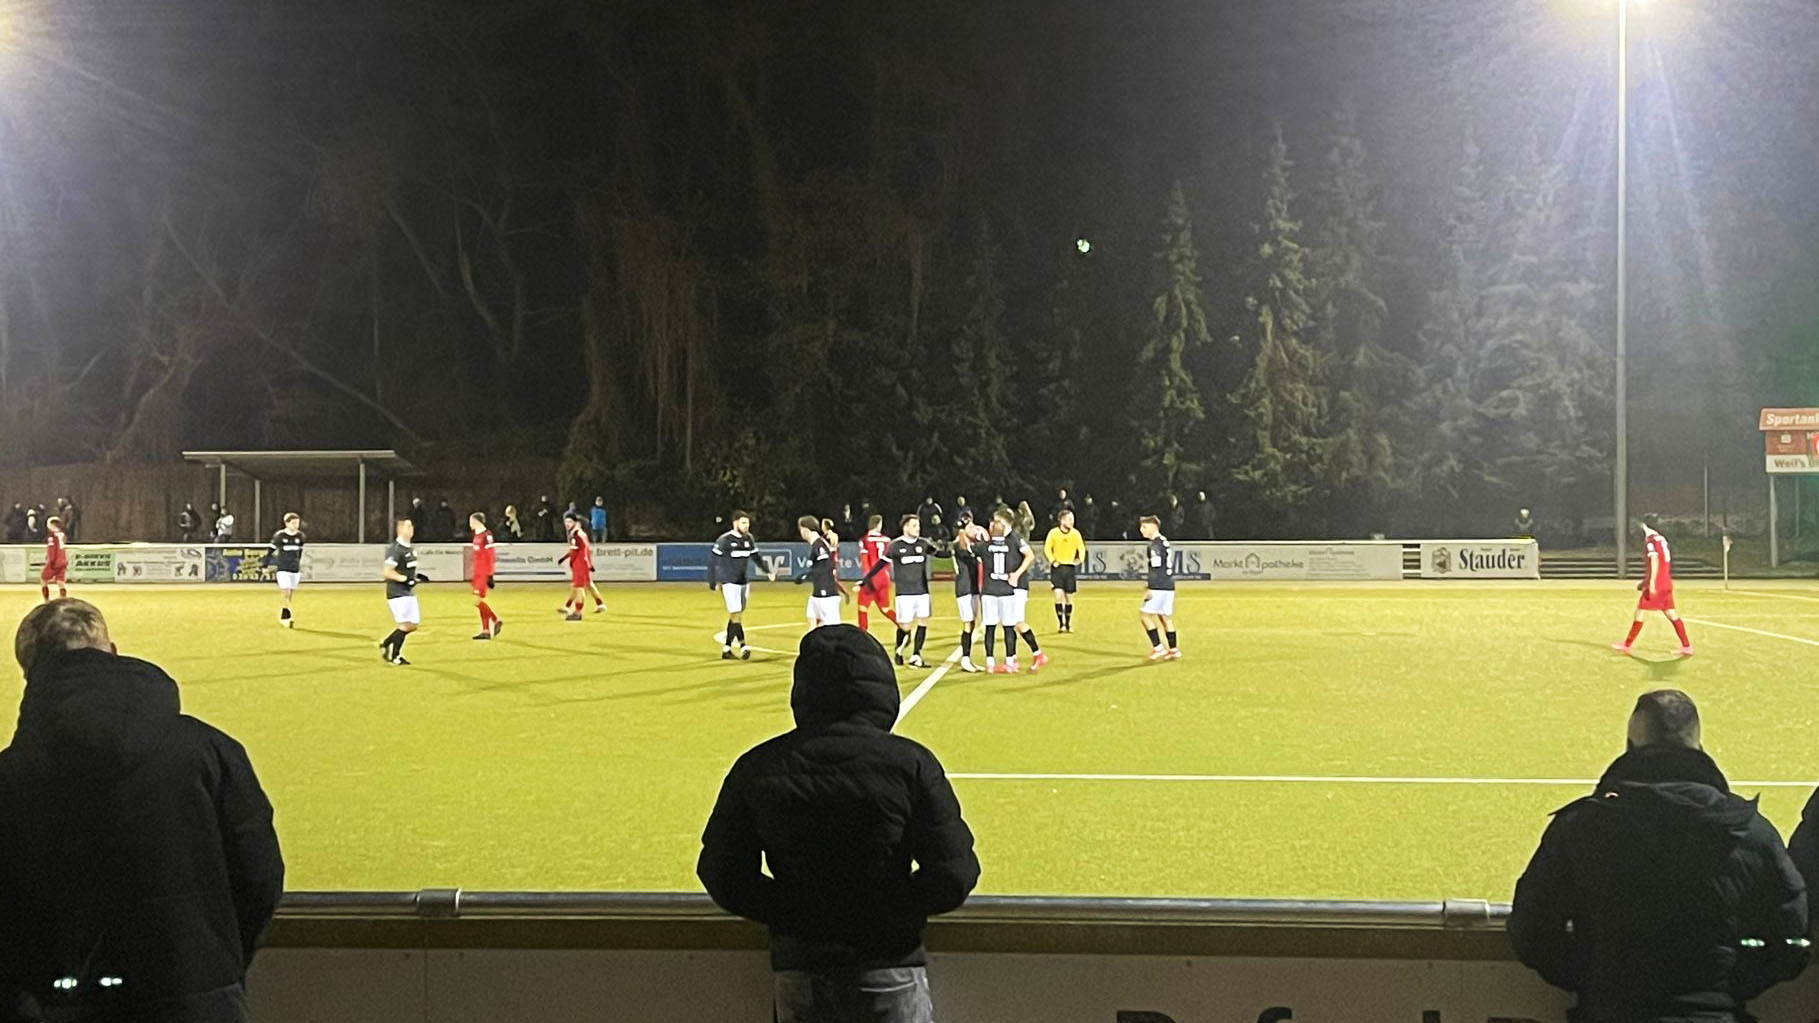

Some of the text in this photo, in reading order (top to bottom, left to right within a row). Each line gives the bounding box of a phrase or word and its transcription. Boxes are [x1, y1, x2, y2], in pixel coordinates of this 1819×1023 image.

[993, 553, 1005, 574] 11
[1213, 559, 1244, 568] Markt
[1459, 548, 1525, 572] Stauder
